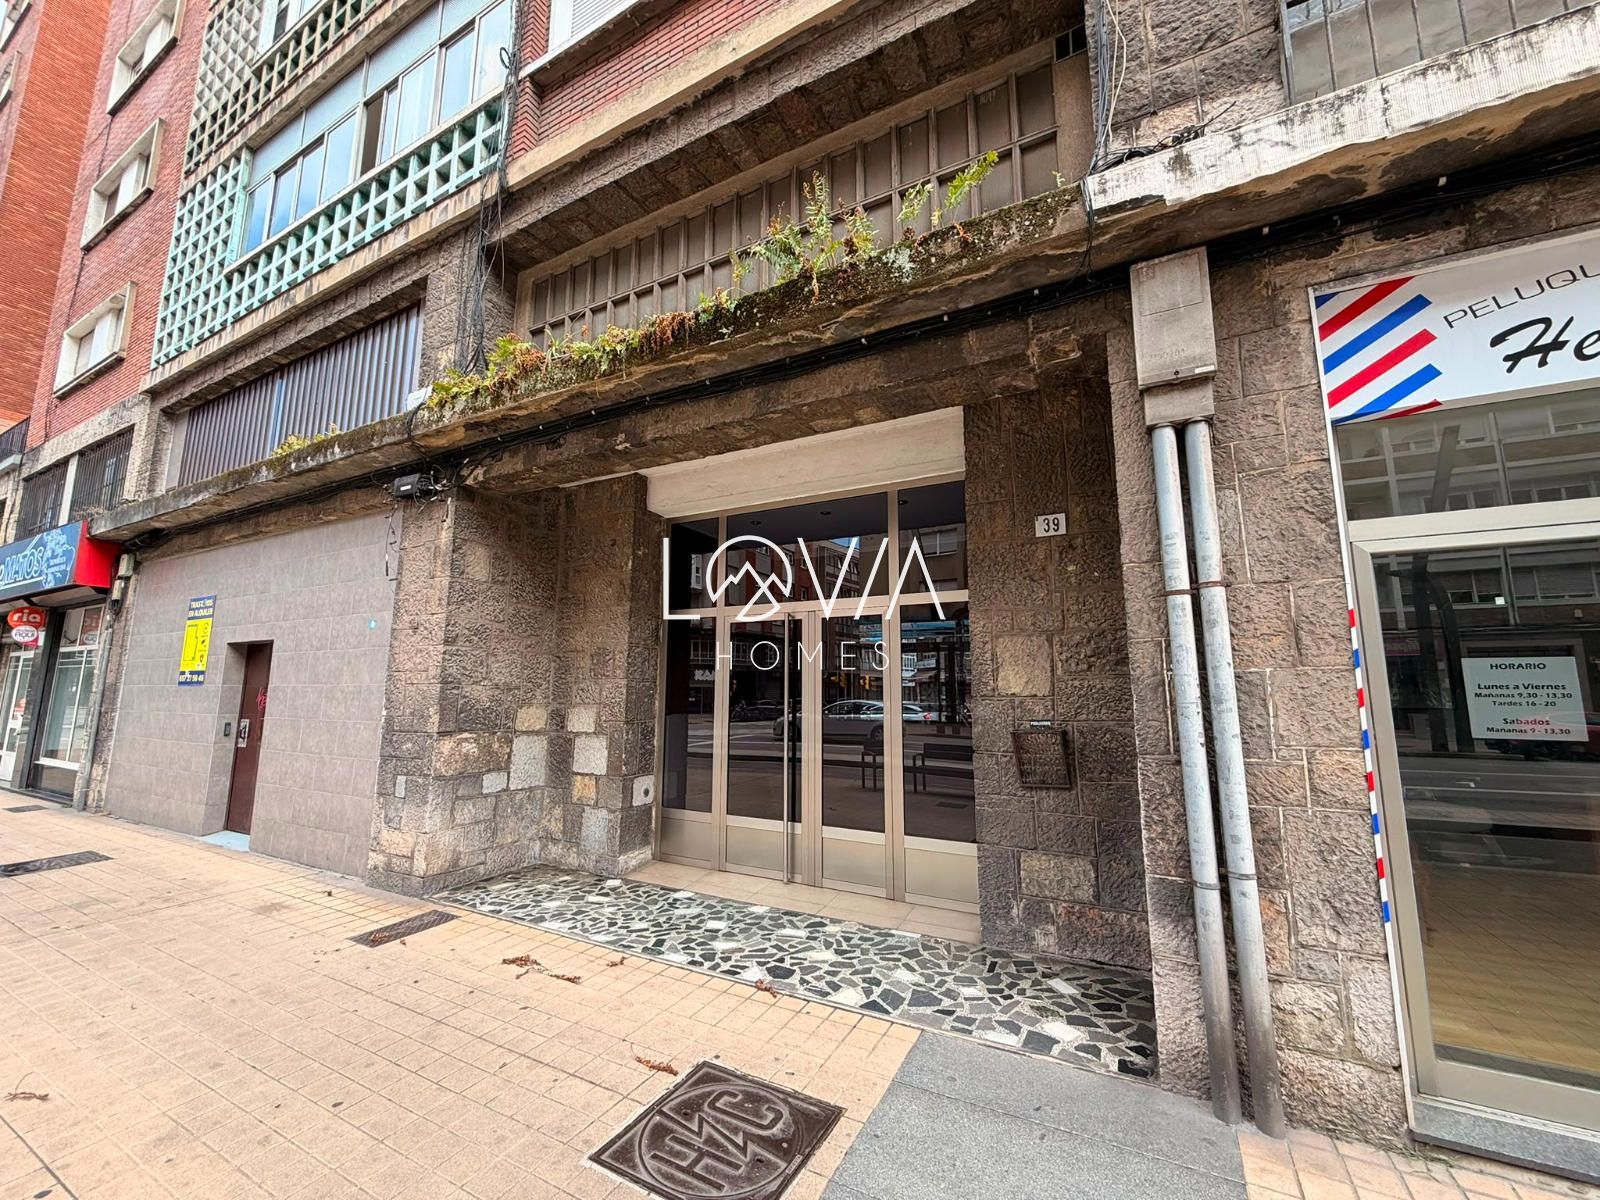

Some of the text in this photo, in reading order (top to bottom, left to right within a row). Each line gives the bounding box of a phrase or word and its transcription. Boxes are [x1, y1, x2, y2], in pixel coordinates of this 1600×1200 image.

[1043, 517, 1060, 533] 39
[13, 609, 41, 622] ria
[1489, 662, 1547, 671] HORARIO
[1521, 682, 1567, 690] Viernes
